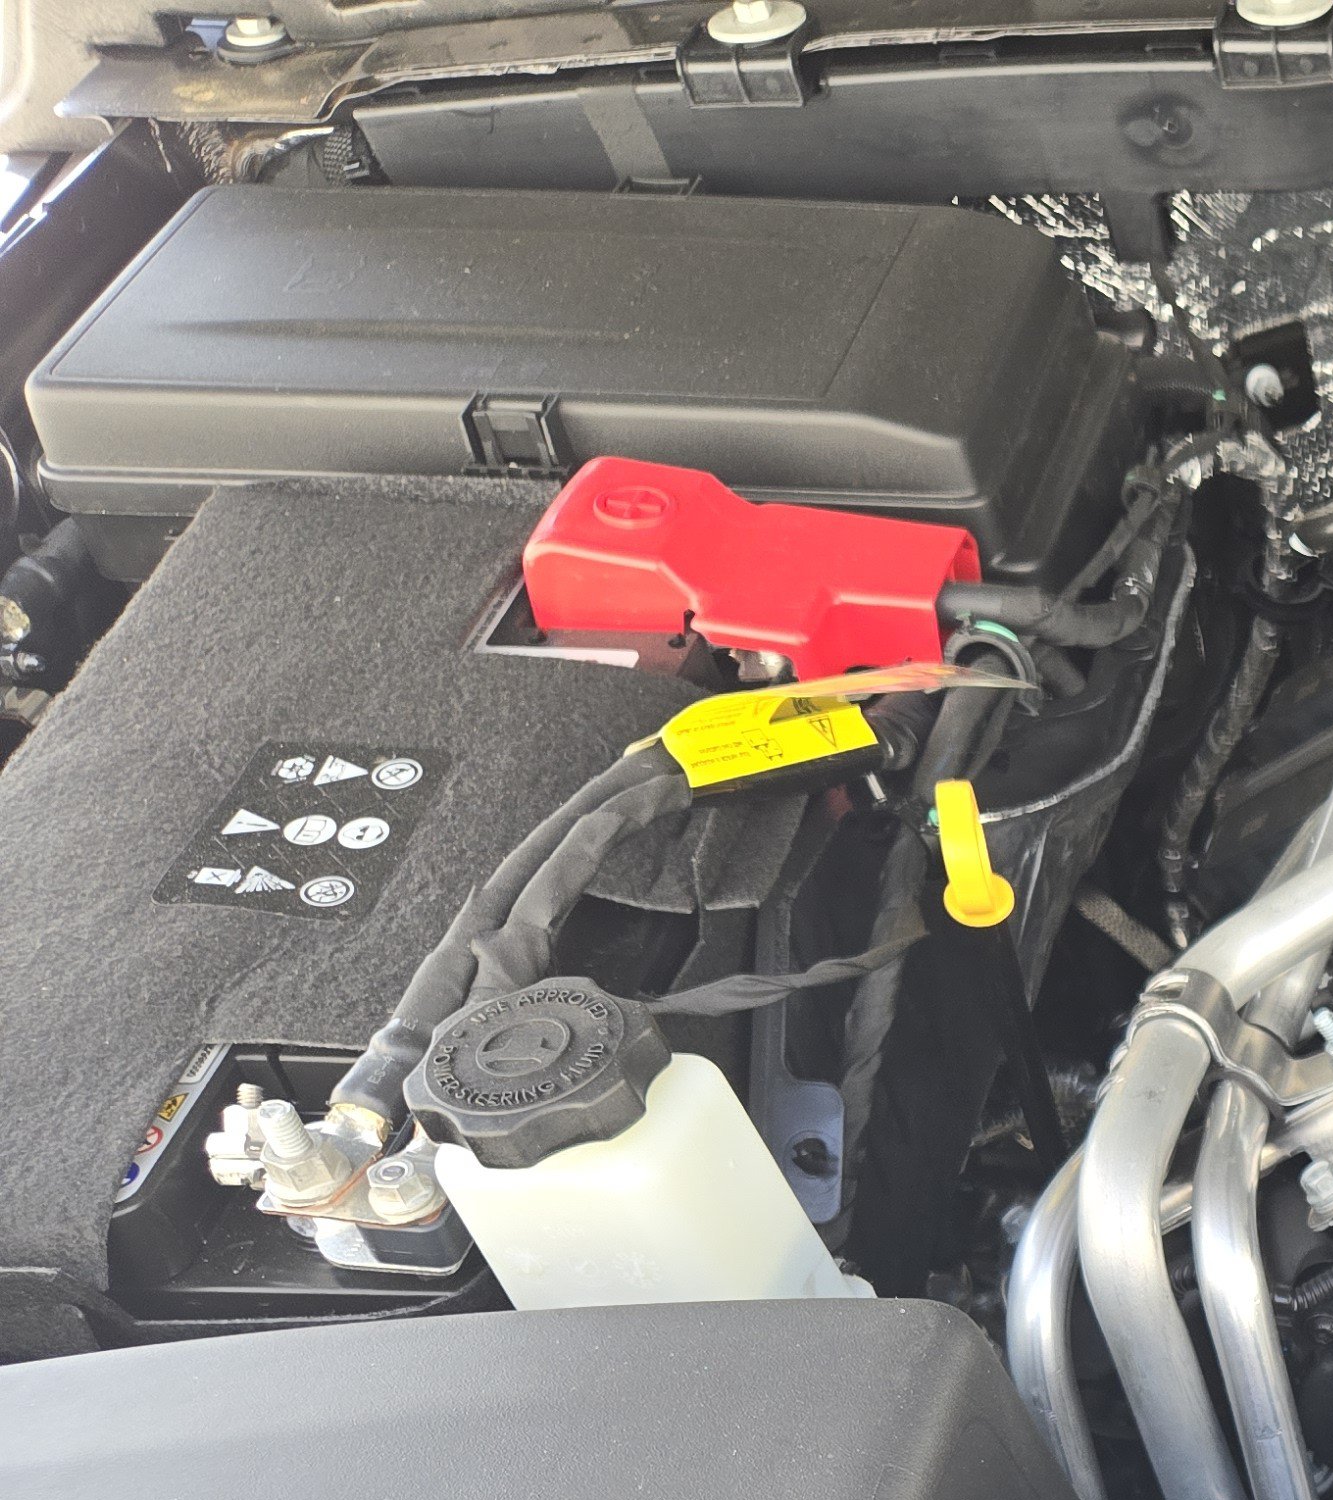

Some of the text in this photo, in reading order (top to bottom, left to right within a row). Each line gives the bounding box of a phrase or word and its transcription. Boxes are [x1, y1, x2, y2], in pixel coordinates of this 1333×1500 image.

[470, 989, 608, 1024] USE APPROVED
[433, 1044, 461, 1093] POWER
[455, 1081, 555, 1107] STEERING
